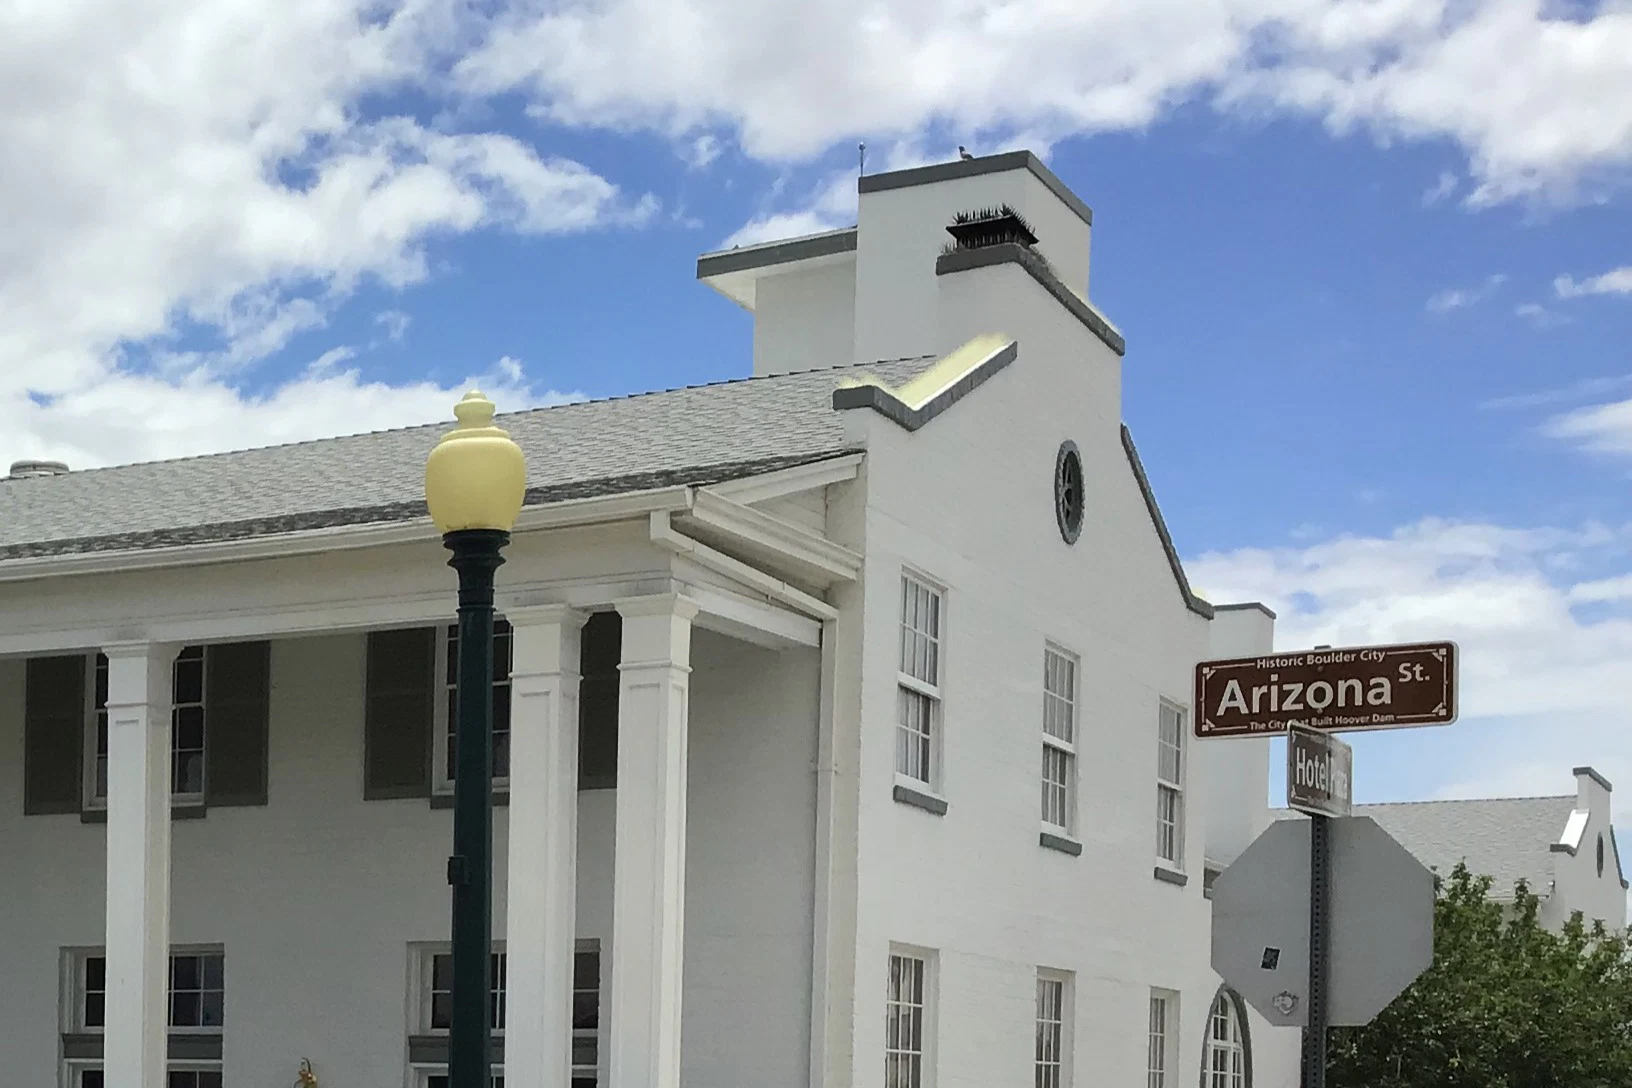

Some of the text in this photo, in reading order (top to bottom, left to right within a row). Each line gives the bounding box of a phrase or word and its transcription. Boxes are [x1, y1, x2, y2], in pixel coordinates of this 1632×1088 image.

[1257, 650, 1386, 669] Historic Boulder City
[1216, 662, 1431, 716] Arizona St.
[1250, 721, 1266, 731] The
[1268, 720, 1286, 730] City
[1311, 716, 1333, 726] Built
[1335, 714, 1370, 724] Hoover
[1372, 714, 1395, 722] Dam
[1296, 747, 1329, 792] Hotel
